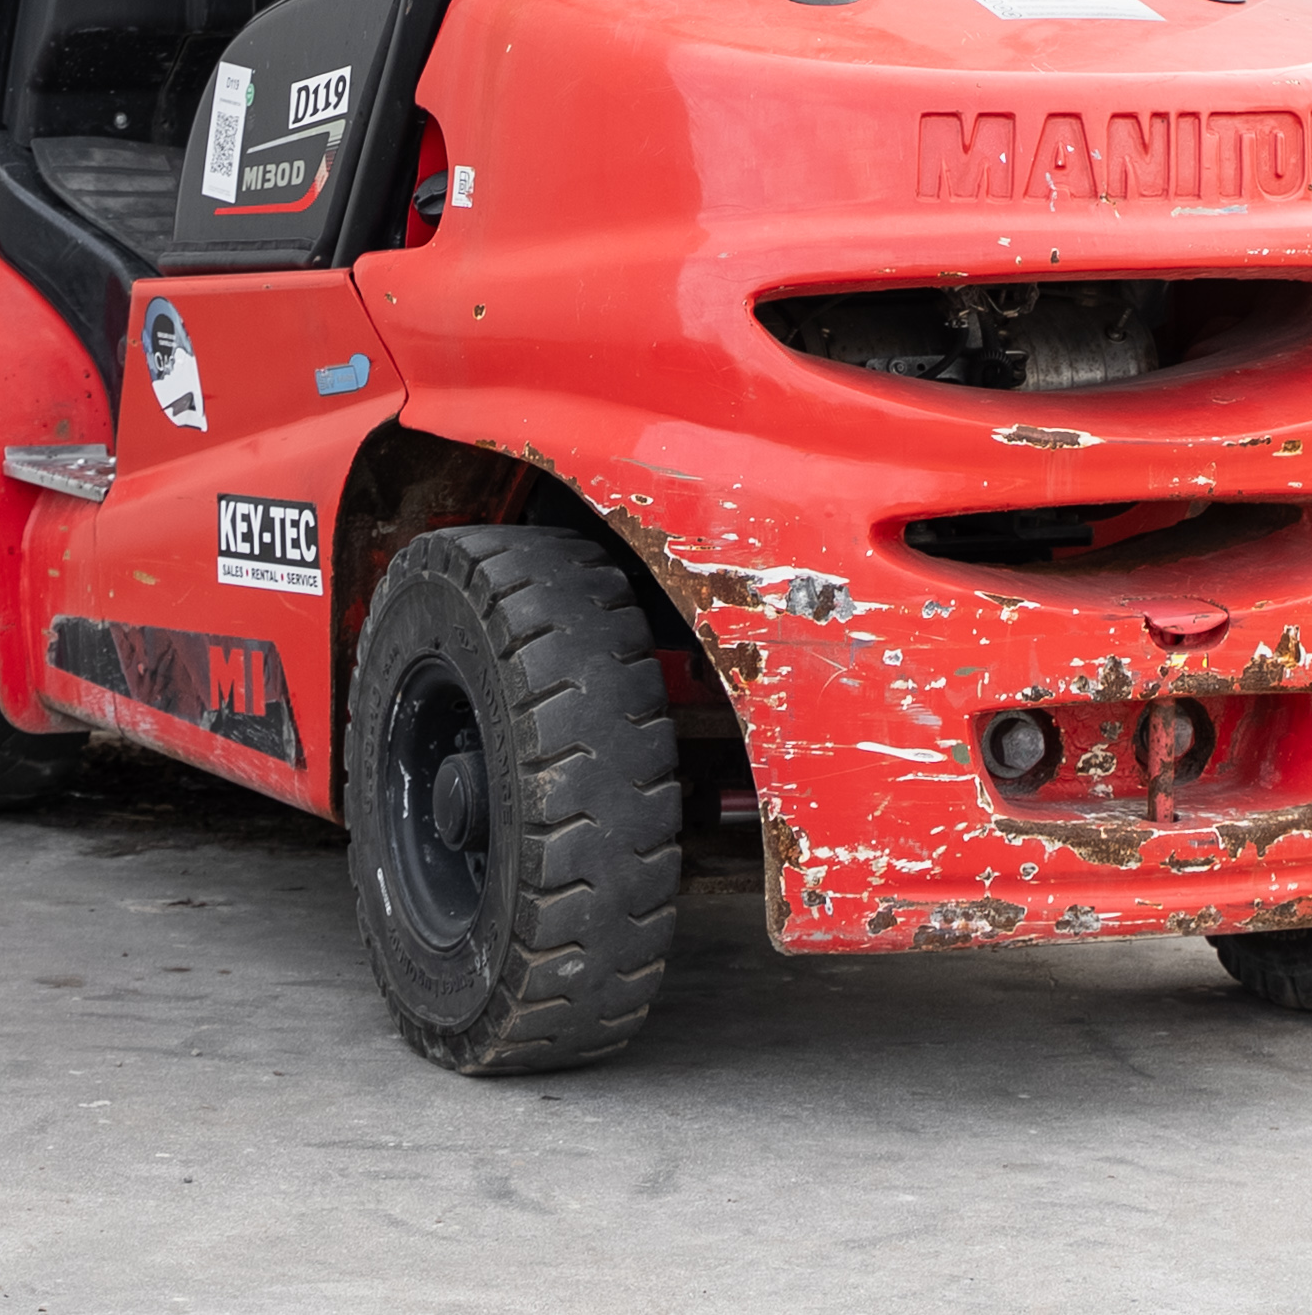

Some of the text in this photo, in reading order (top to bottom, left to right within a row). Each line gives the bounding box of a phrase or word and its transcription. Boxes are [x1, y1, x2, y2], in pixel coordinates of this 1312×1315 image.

[292, 74, 348, 125] D119
[220, 500, 317, 562] KEY-TEC
[222, 564, 319, 588] SALES RENTAL SERVICE
[209, 646, 266, 717] MI
